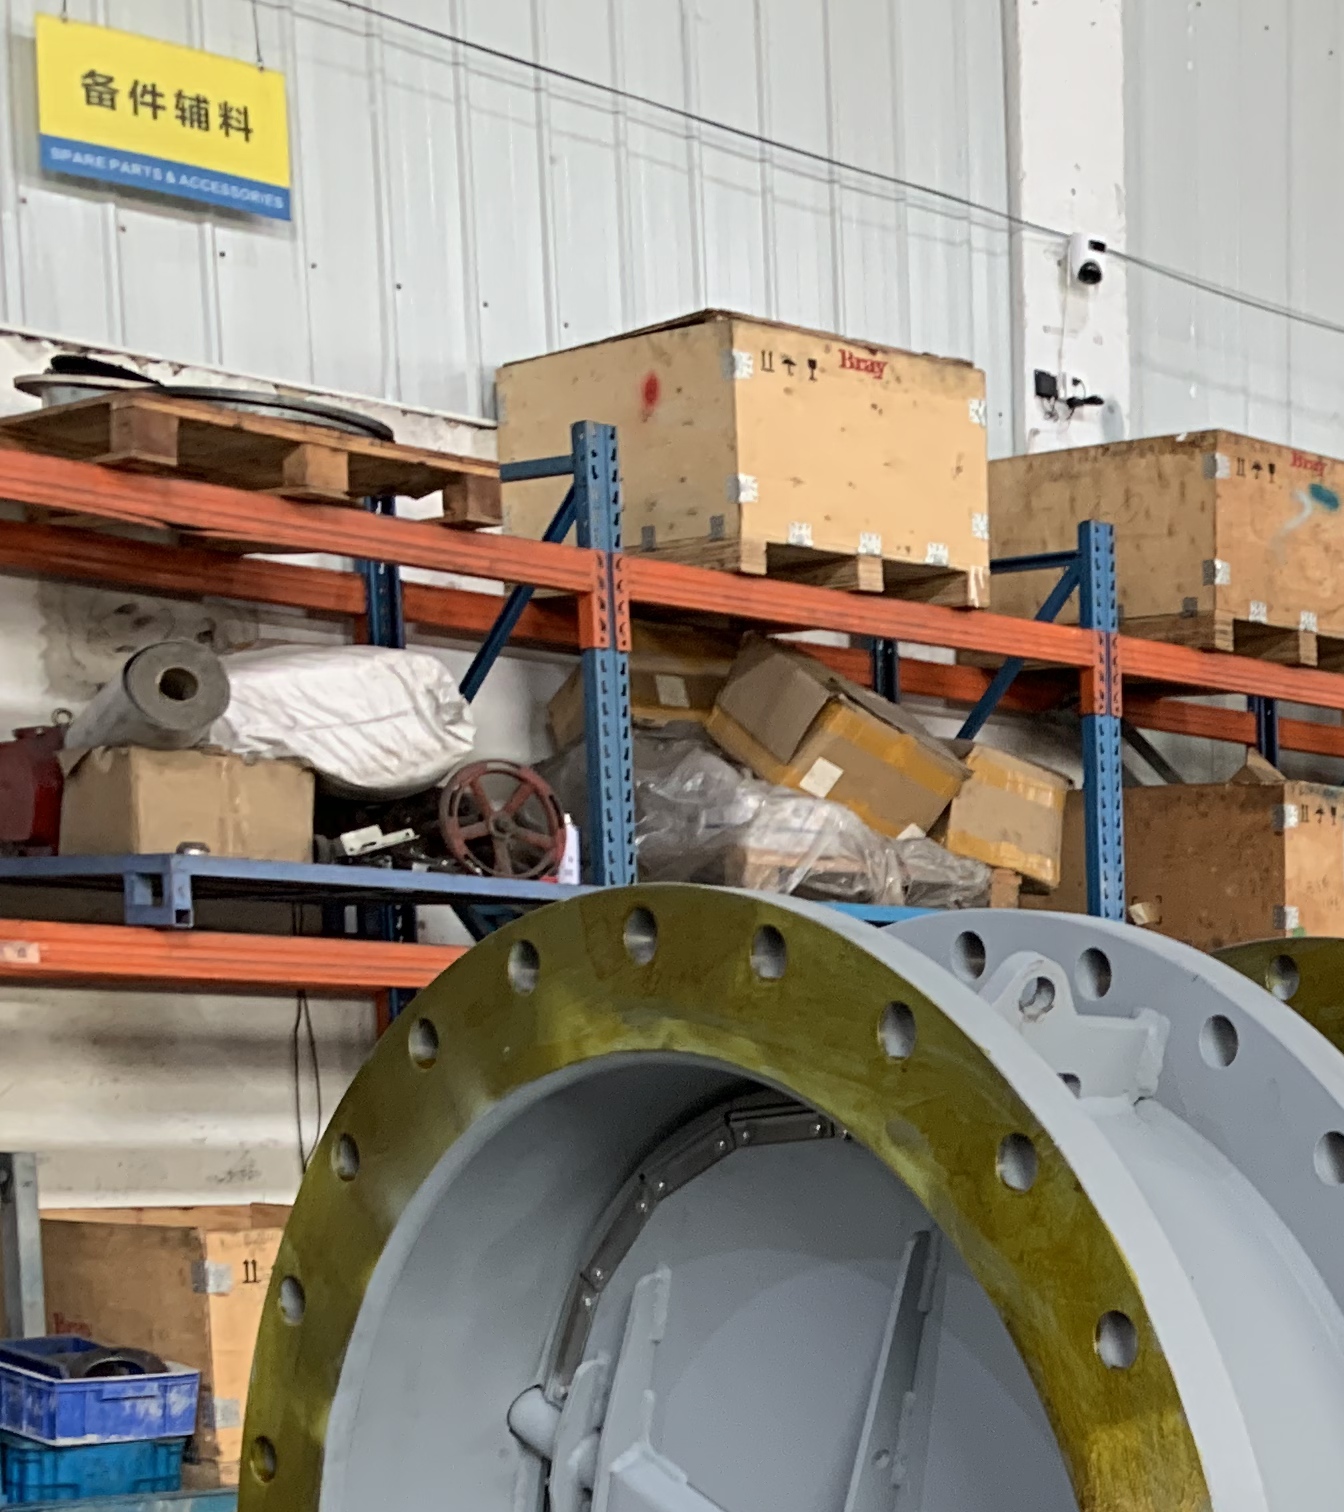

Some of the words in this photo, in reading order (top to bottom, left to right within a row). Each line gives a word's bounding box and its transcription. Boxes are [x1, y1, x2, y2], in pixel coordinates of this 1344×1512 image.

[81, 69, 253, 143] 备件辅料
[50, 147, 106, 170] SPARE
[108, 158, 163, 182] PARTS
[165, 171, 176, 184] &
[179, 175, 285, 209] ACCESSORIES
[838, 349, 888, 380] Bray
